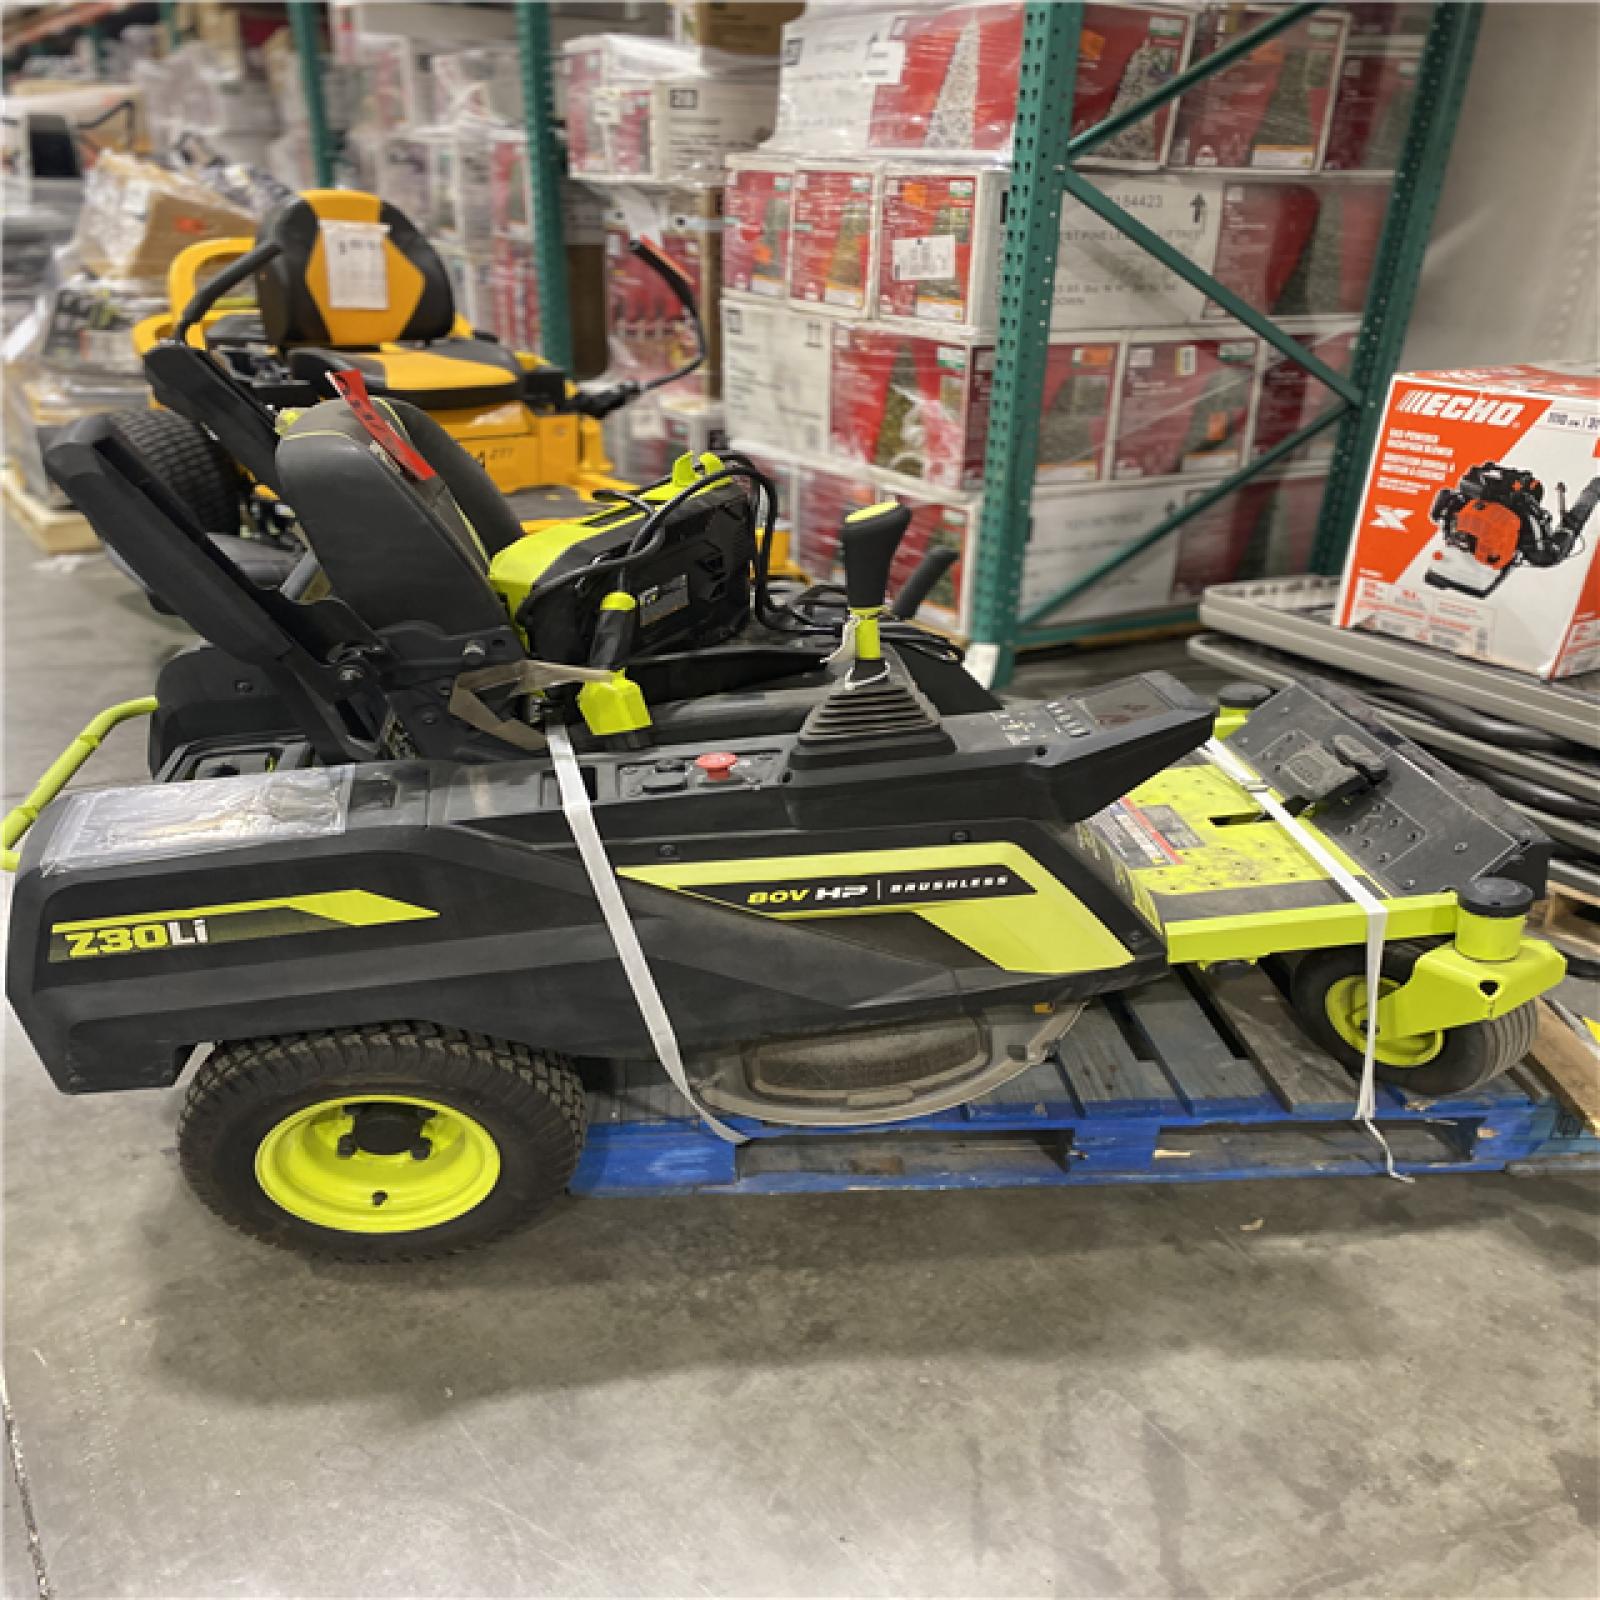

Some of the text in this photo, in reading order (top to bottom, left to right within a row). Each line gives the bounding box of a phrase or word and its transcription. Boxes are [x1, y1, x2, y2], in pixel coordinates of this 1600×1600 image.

[1421, 392, 1525, 426] ECHO
[747, 874, 1009, 904] 80V HP BRUSHLESS
[65, 918, 209, 959] Z30Li
